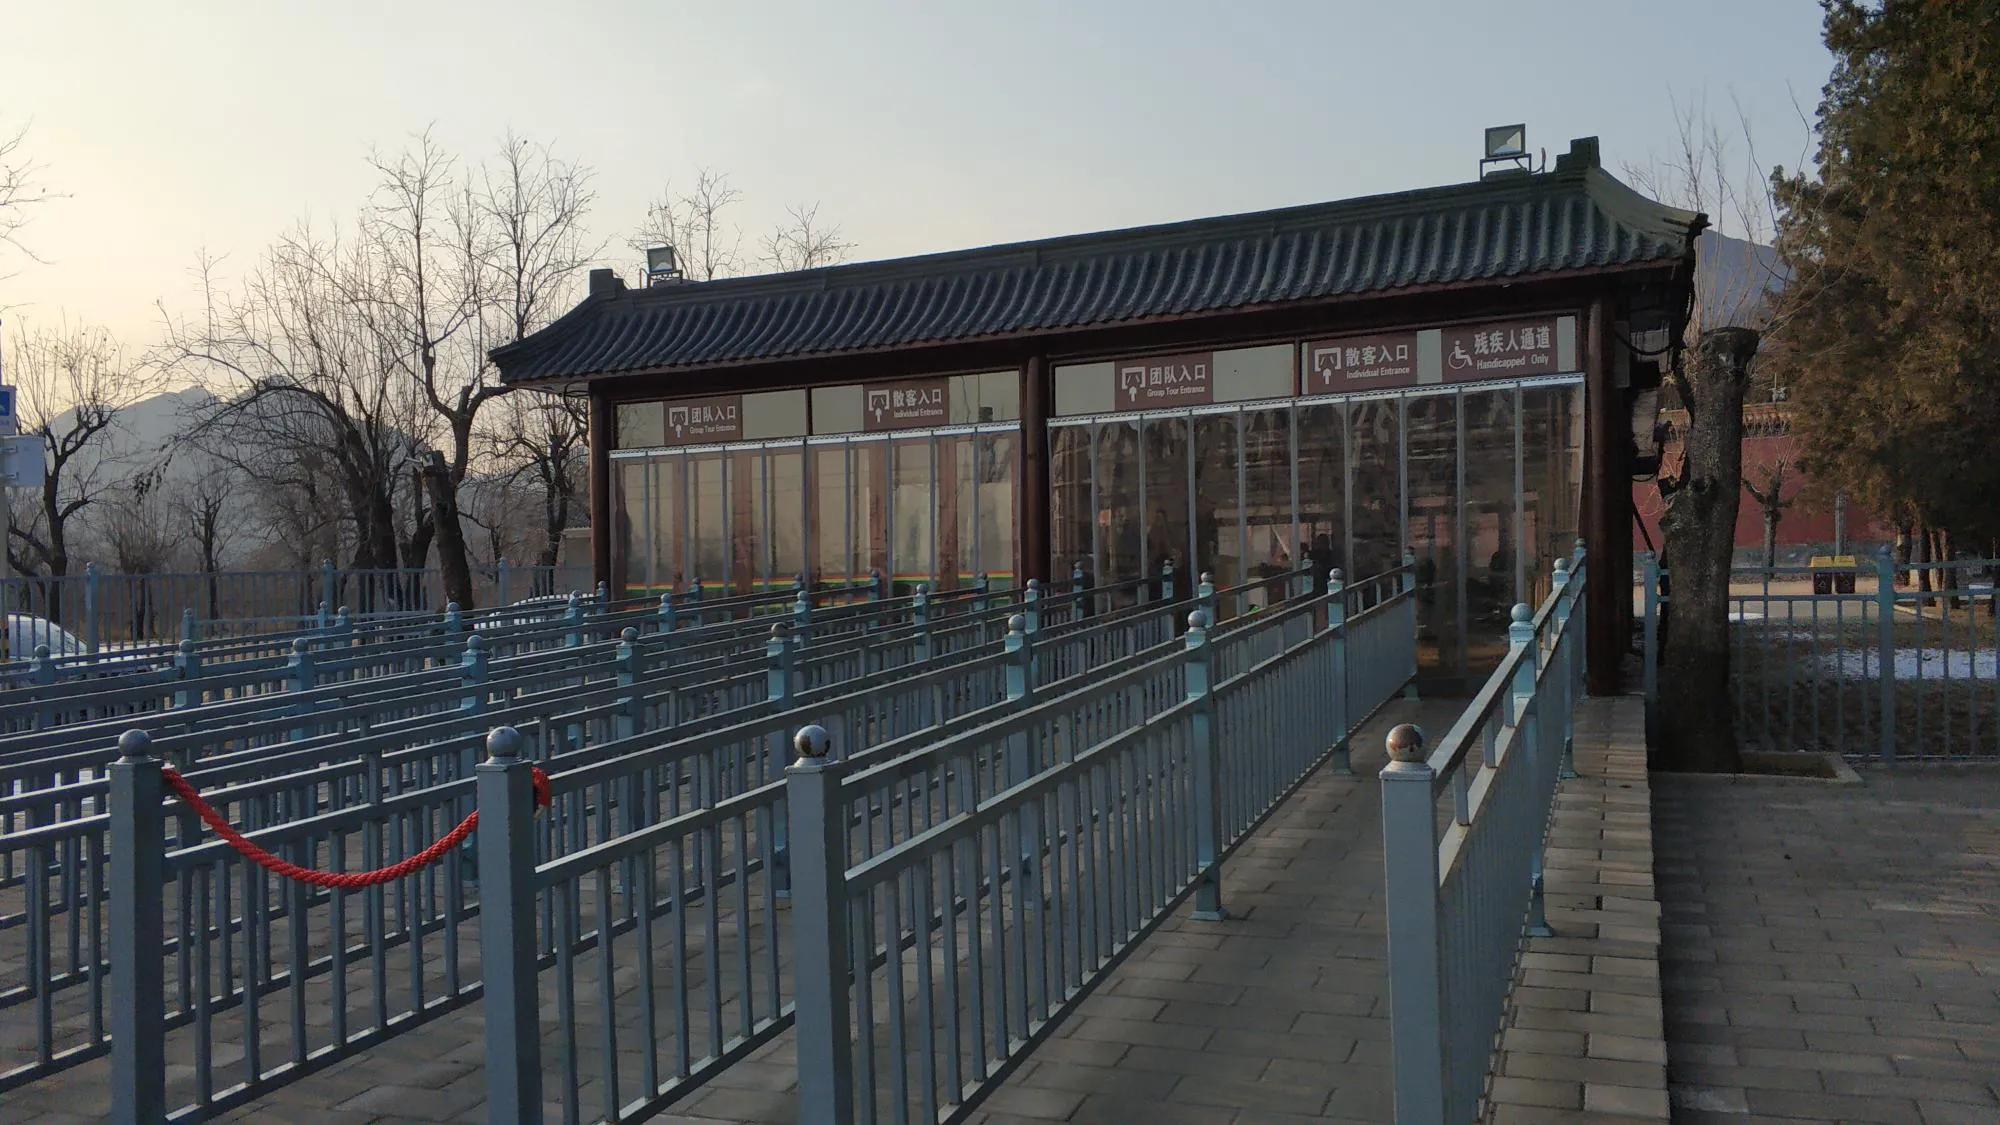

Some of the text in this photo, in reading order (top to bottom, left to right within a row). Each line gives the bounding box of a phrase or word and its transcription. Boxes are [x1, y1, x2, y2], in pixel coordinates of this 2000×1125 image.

[1474, 326, 1550, 354] 残疾人通道
[1345, 344, 1408, 367] 散客入口
[1477, 354, 1549, 370] Handicapped Only
[1149, 364, 1206, 385] 团队入口
[1346, 366, 1410, 379] Individual Entrance
[893, 388, 942, 407] 散客入口
[1147, 386, 1205, 398] Group Tour Entrance
[691, 406, 736, 423] 团队入口
